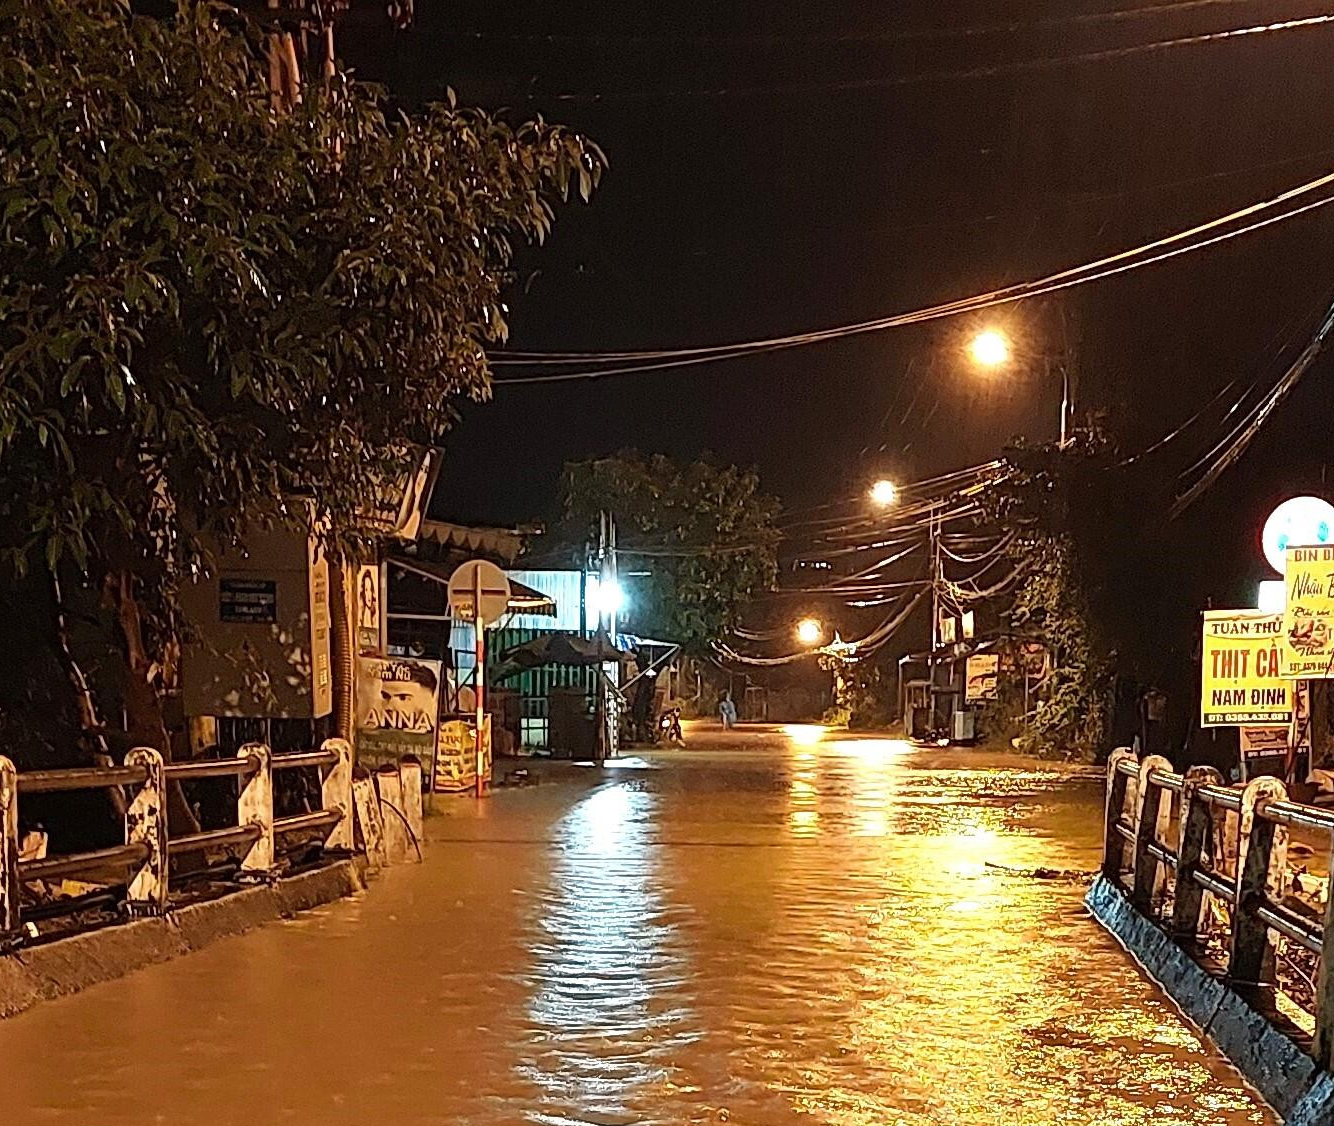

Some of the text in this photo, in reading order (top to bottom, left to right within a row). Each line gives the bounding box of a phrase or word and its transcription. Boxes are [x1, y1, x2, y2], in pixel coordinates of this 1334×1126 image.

[1210, 648, 1251, 685] THỊT
[1211, 687, 1287, 710] NAM ĐỊNH
[363, 707, 432, 733] ANNA
